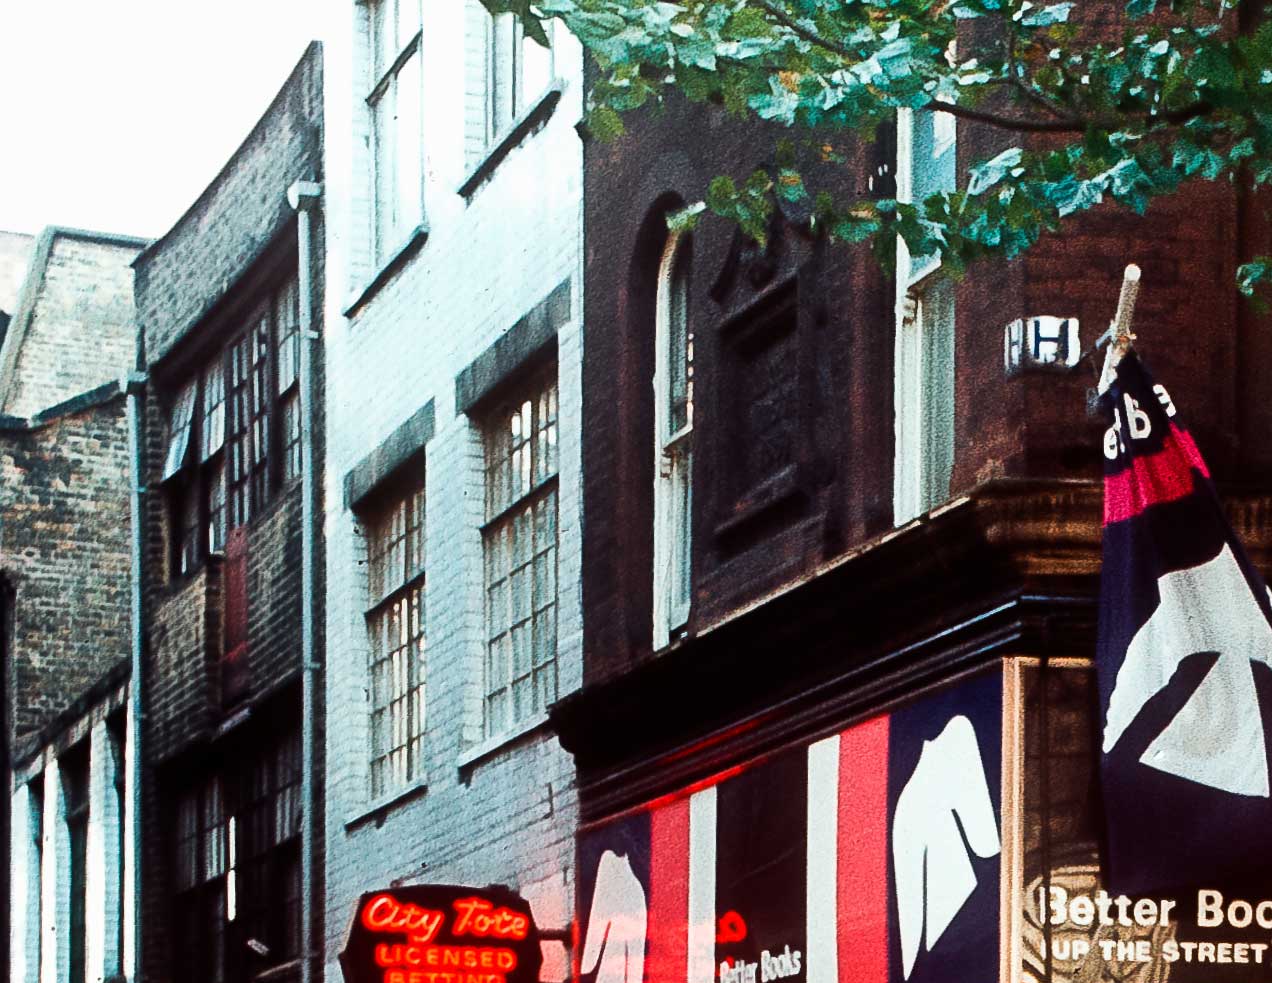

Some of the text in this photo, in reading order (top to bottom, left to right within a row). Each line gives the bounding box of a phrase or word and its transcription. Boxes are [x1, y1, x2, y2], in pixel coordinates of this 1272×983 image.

[1039, 886, 1176, 926] Better
[378, 946, 515, 969] LICENSED
[1099, 941, 1153, 962] THE
